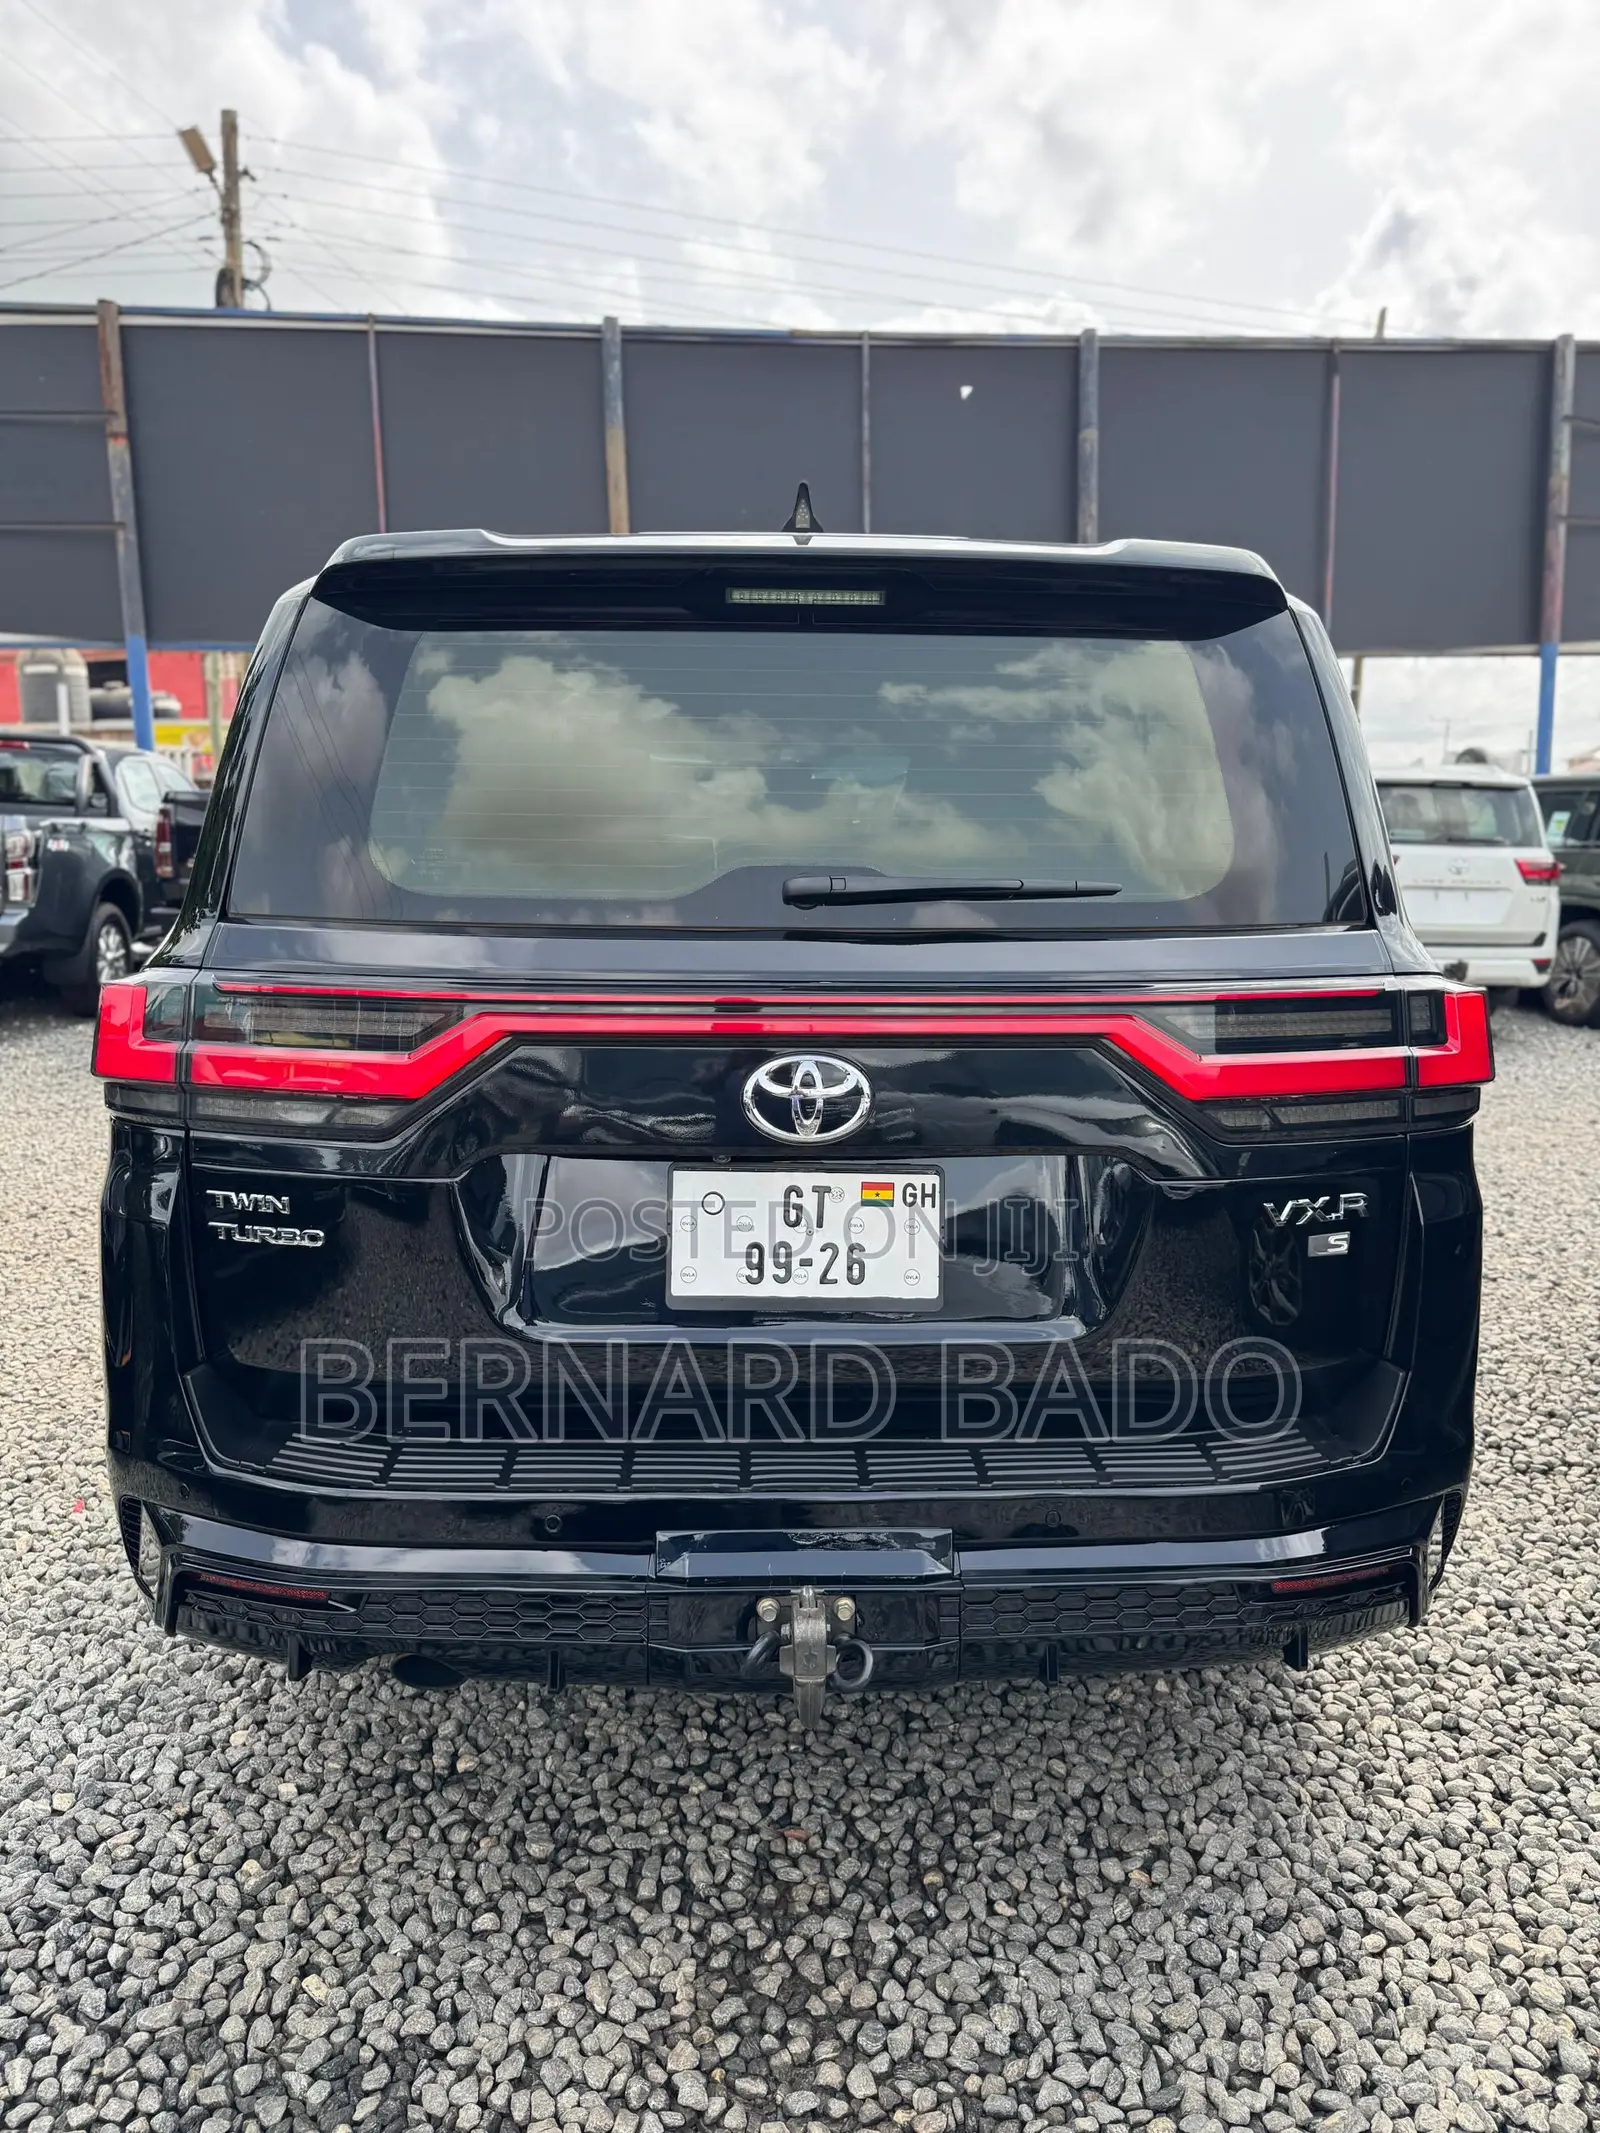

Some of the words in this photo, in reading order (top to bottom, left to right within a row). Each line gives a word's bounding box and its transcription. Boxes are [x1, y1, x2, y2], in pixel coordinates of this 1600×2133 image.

[206, 1189, 290, 1215] TWIN
[783, 1184, 831, 1228] GT
[902, 1182, 936, 1208] GH
[208, 1221, 325, 1247] TURBO
[744, 1240, 866, 1286] 99-26
